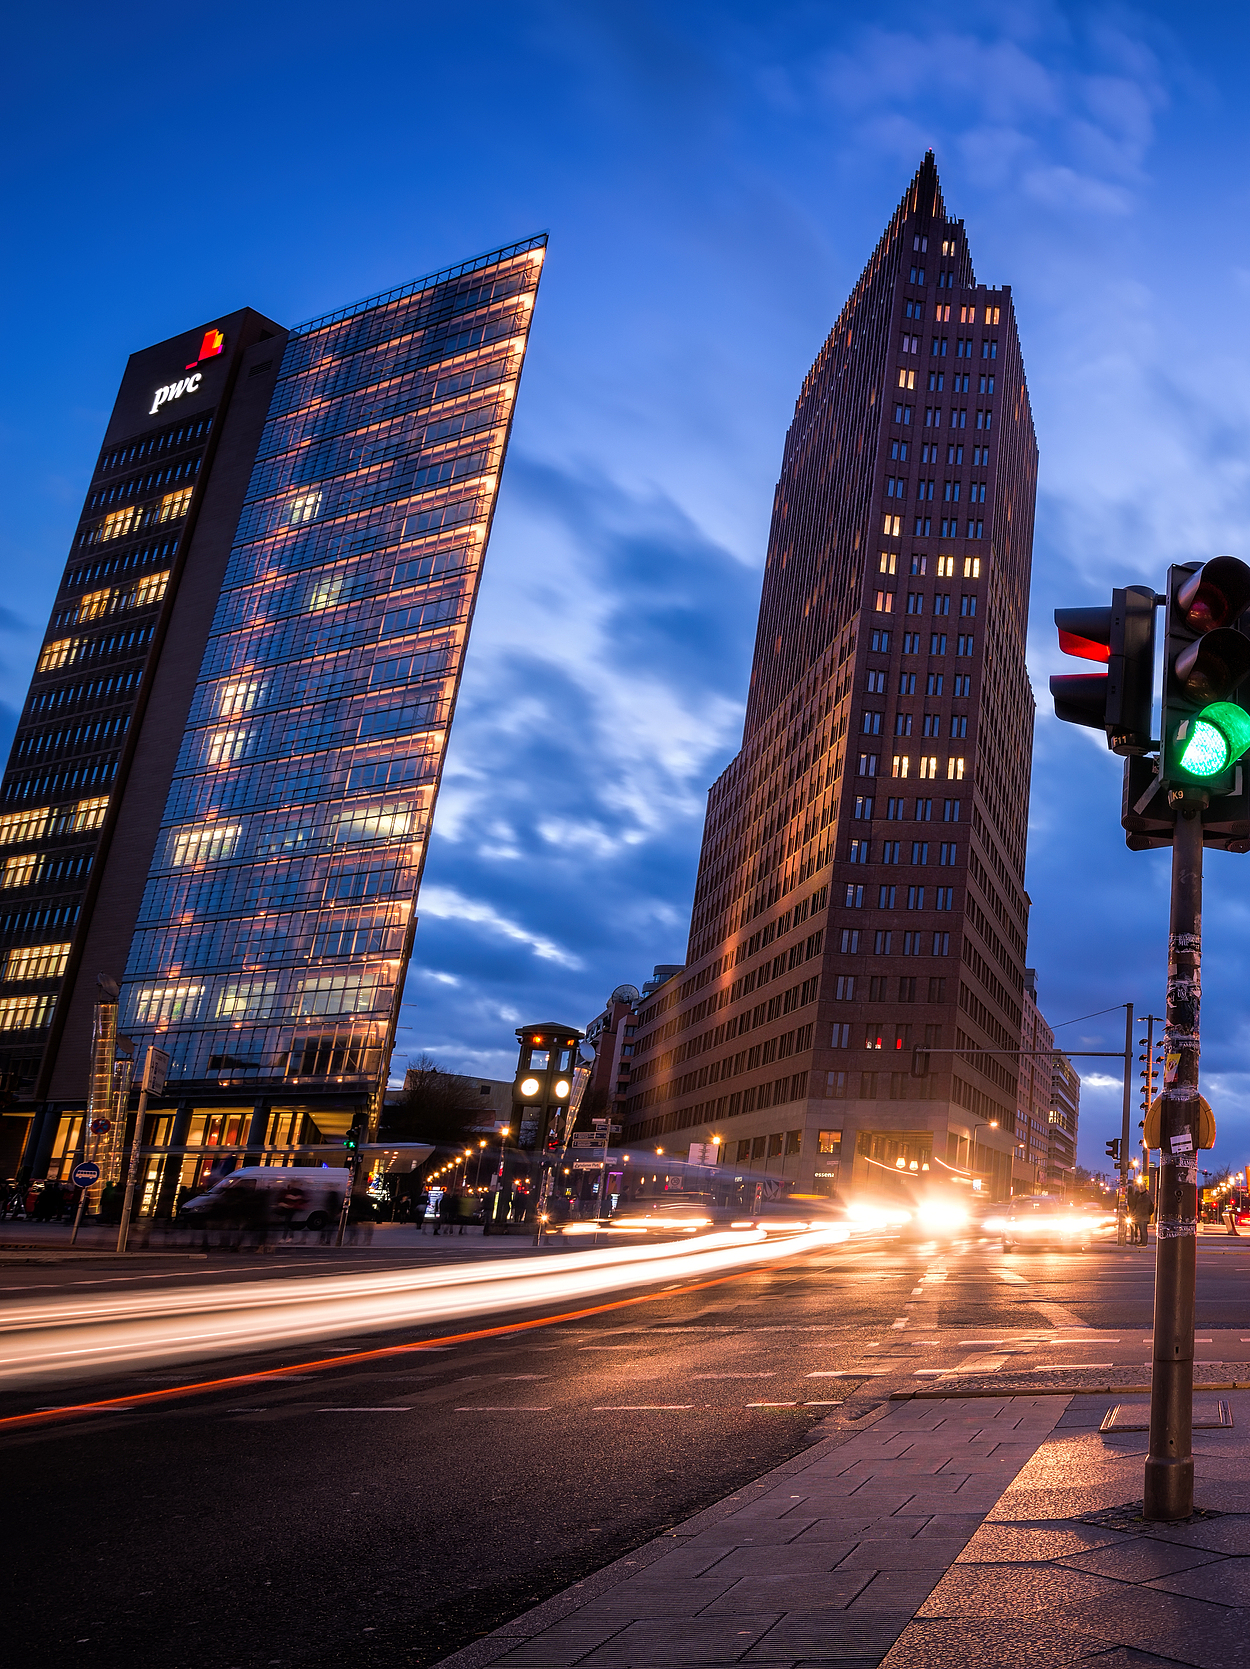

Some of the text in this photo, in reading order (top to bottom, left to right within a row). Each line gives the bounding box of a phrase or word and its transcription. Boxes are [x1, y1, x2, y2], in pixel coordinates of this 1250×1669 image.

[149, 373, 202, 414] pwc
[1114, 735, 1127, 747] F11
[1172, 790, 1184, 800] K9
